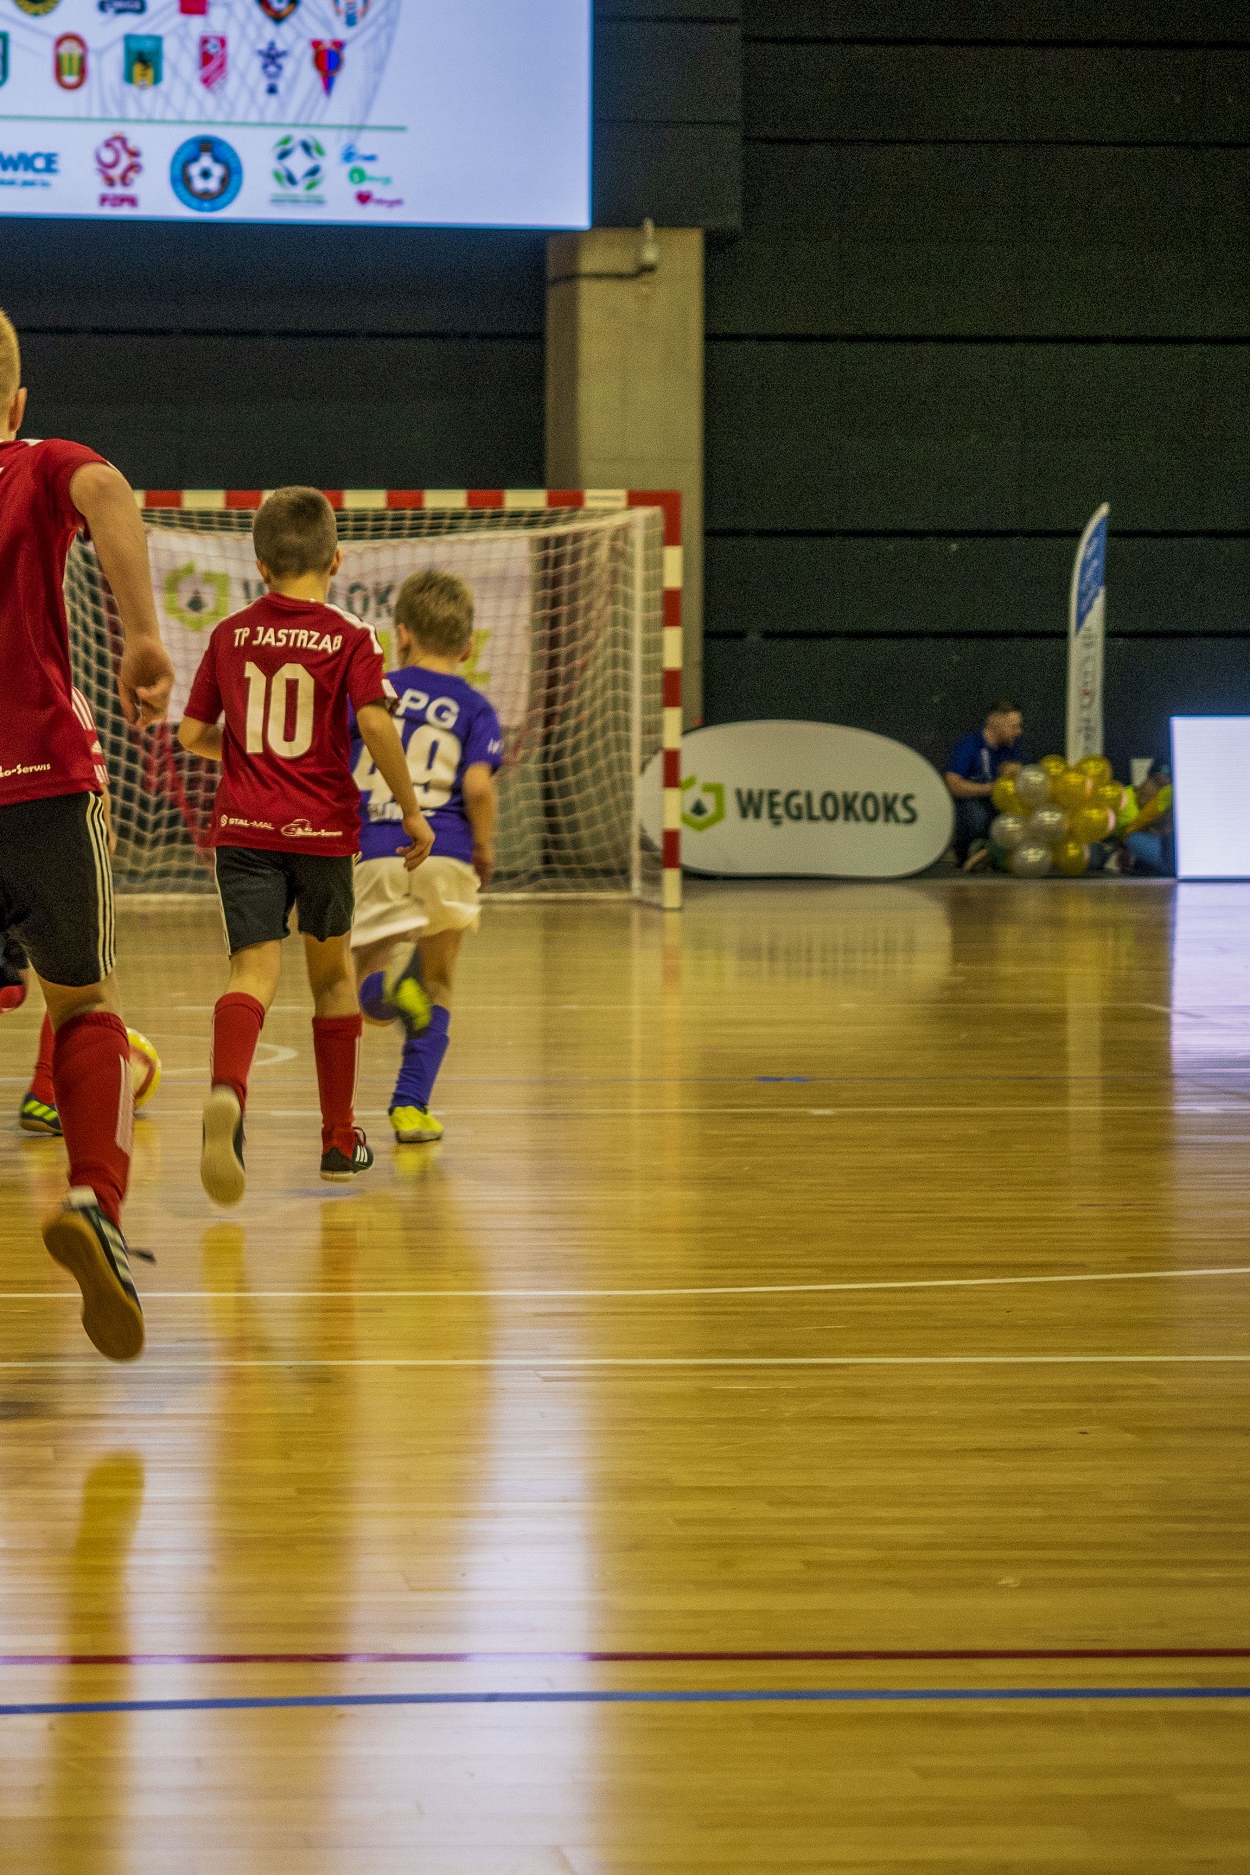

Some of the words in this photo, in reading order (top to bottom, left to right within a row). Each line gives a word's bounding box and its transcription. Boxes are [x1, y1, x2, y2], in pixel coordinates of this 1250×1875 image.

[234, 627, 250, 648] TP
[245, 661, 315, 759] 10
[395, 688, 461, 730] PG
[735, 787, 918, 827] WĘGLOKOKS
